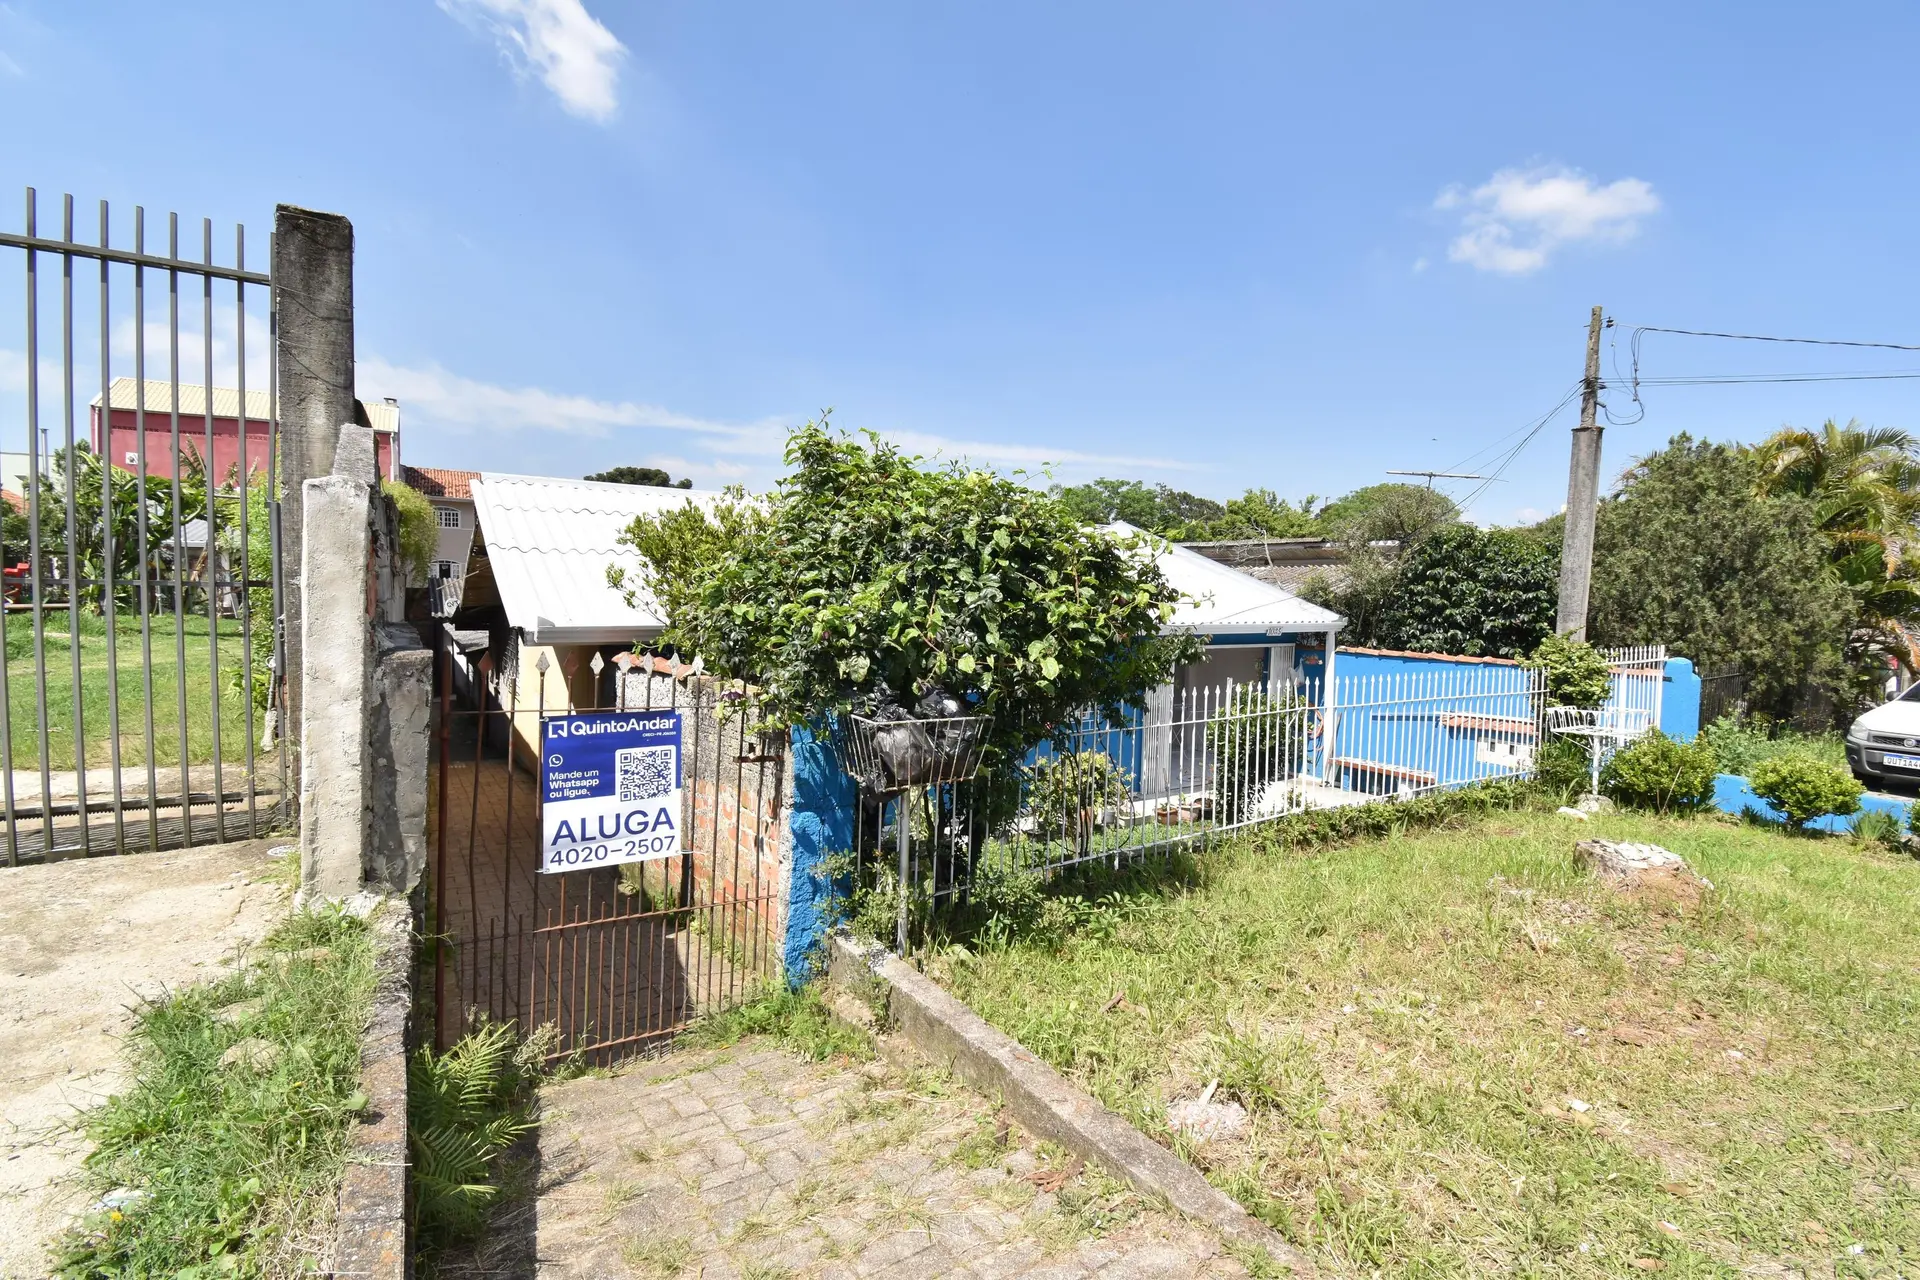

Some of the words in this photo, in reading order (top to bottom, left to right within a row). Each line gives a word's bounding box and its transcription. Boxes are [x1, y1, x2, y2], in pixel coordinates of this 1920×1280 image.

[571, 718, 676, 735] QuintoAndar
[549, 770, 583, 781] Mande
[549, 778, 600, 790] Whatsapp
[549, 790, 562, 798] ou
[550, 806, 675, 847] ALUGA
[549, 835, 676, 866] 4020-2507
